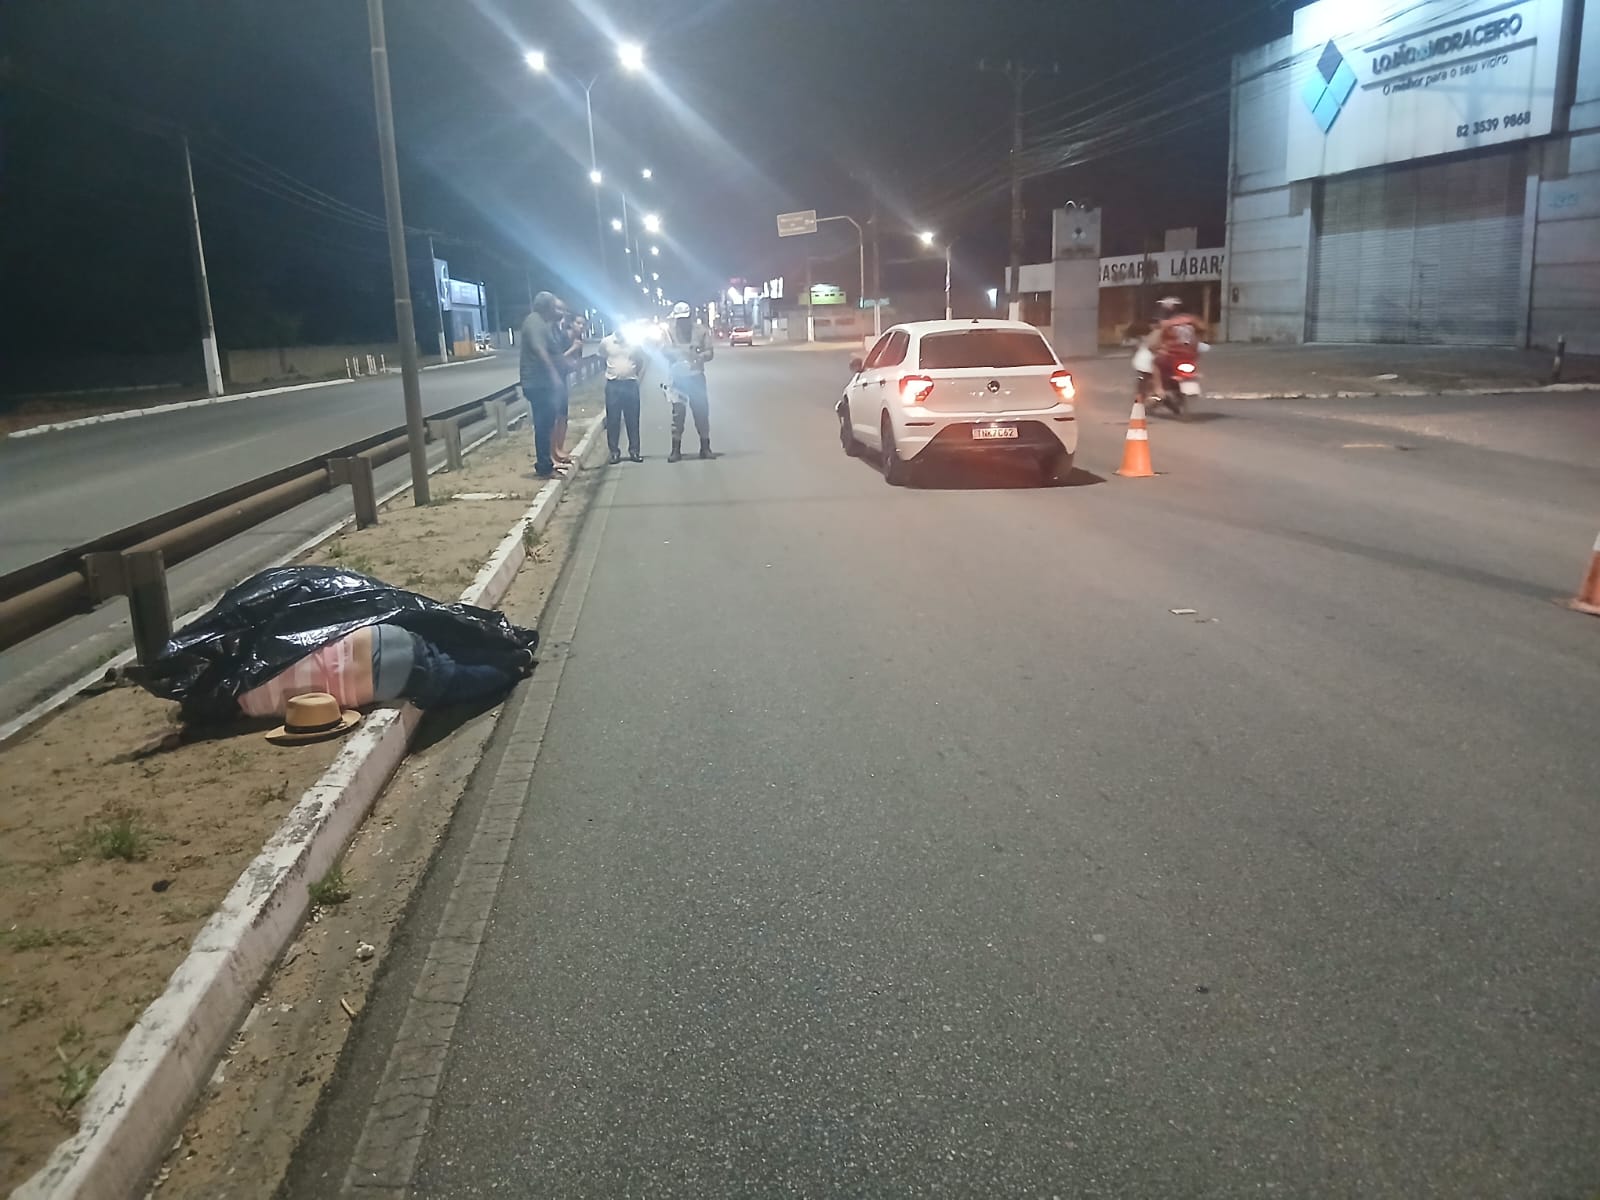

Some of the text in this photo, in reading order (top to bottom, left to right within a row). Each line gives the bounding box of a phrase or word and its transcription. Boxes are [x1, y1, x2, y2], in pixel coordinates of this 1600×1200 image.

[1429, 13, 1523, 57] VIDRACEIRO
[1383, 53, 1508, 96] O melhor para o seu vidro
[1456, 111, 1531, 138] 82 3539 9868
